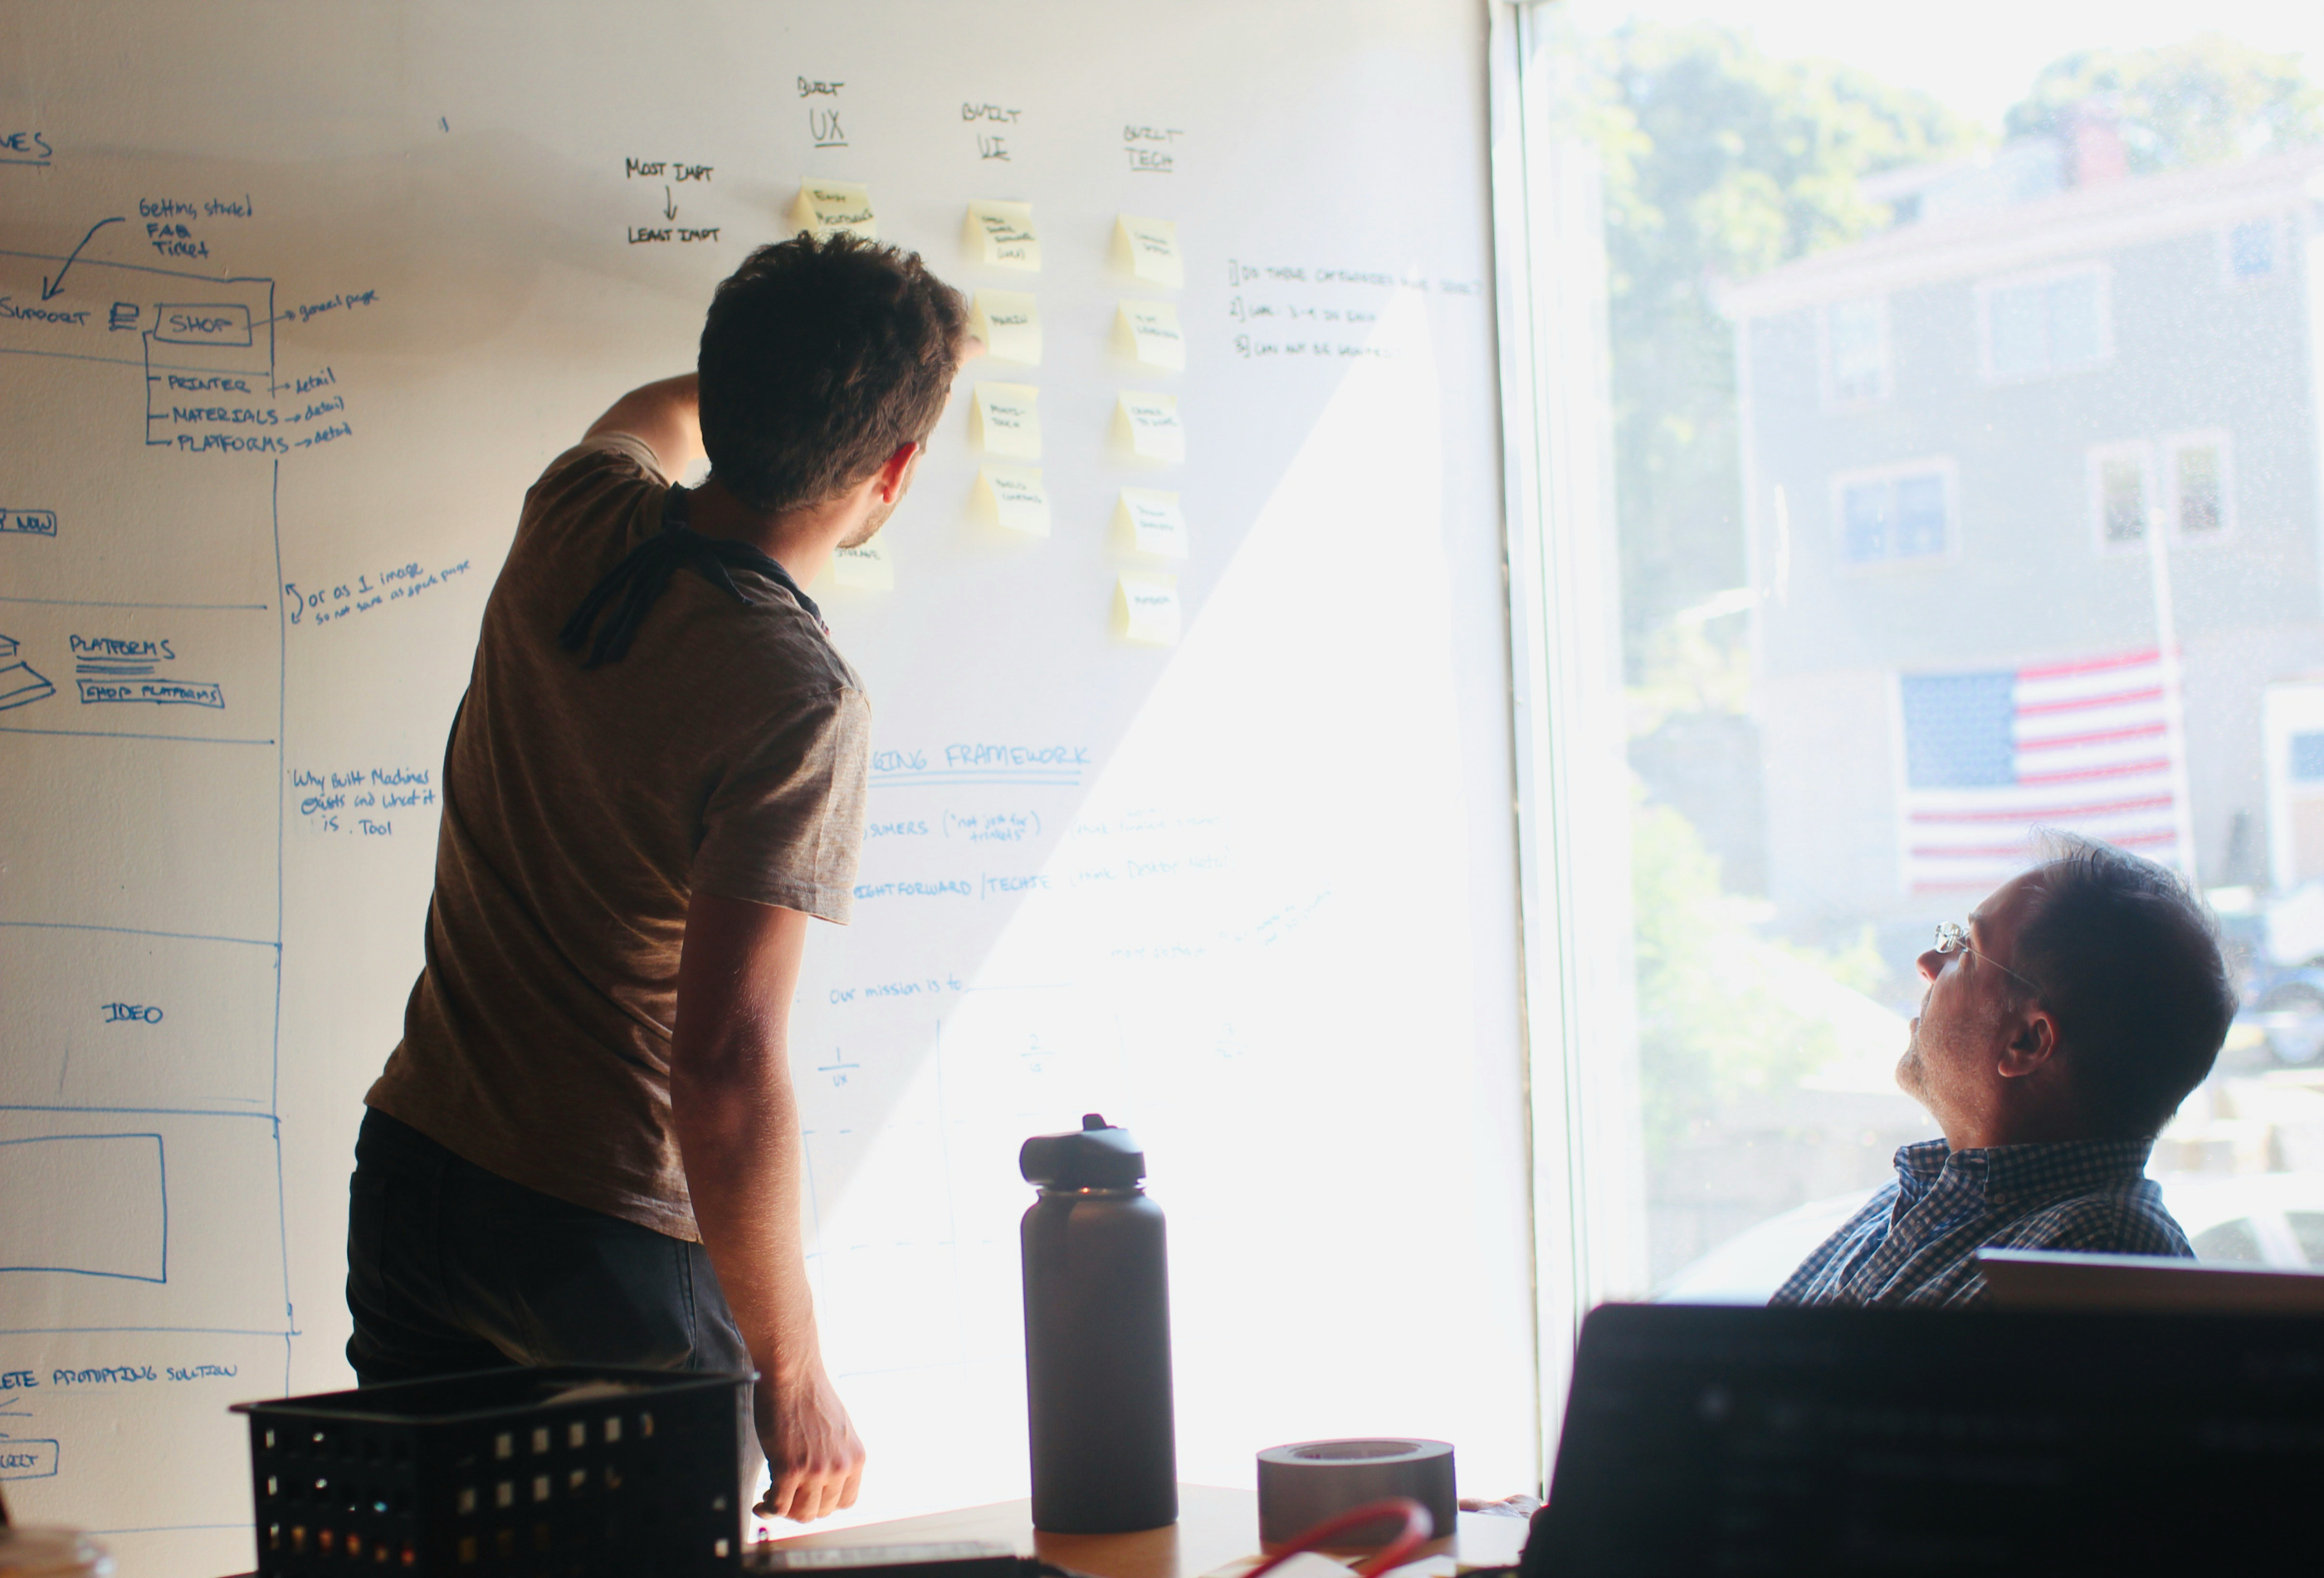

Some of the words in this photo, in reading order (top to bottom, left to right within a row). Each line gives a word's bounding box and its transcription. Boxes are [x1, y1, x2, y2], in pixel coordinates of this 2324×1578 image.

[962, 102, 1022, 124] BUILT
[810, 108, 845, 141] UX
[1124, 125, 1184, 144] BUILT
[976, 133, 1009, 161] UI
[1124, 147, 1174, 167] TECH
[626, 157, 666, 178] MOST
[146, 223, 191, 239] FAQ
[628, 226, 673, 245] LEAST
[152, 241, 209, 259] Ticket
[169, 314, 233, 333] SHOP
[168, 374, 251, 394] PRINTER
[295, 366, 336, 395] detail
[173, 407, 279, 425] MATERIALS
[178, 433, 289, 454] PLATFORMS
[308, 589, 325, 608] or
[333, 584, 352, 600] as
[379, 562, 424, 585] image
[334, 604, 351, 619] not
[390, 586, 405, 601] as
[70, 634, 176, 660] PLATFORMS
[86, 686, 131, 700] SHOP
[140, 686, 217, 704] PLATFORMS
[869, 749, 928, 773] GING
[945, 742, 1091, 769] FRAMEWORK
[293, 769, 325, 794] Why
[331, 770, 366, 789] Built
[370, 767, 429, 786] Machines
[300, 793, 345, 816] exists
[354, 791, 375, 809] and
[422, 789, 436, 805] it
[320, 815, 339, 833] is
[358, 818, 392, 836] Tool
[863, 820, 930, 840] SUMERS
[865, 982, 922, 998] mission
[926, 979, 940, 993] is
[946, 972, 962, 991] to
[100, 1002, 164, 1024] IDEO
[166, 1364, 238, 1381] SOLUTION
